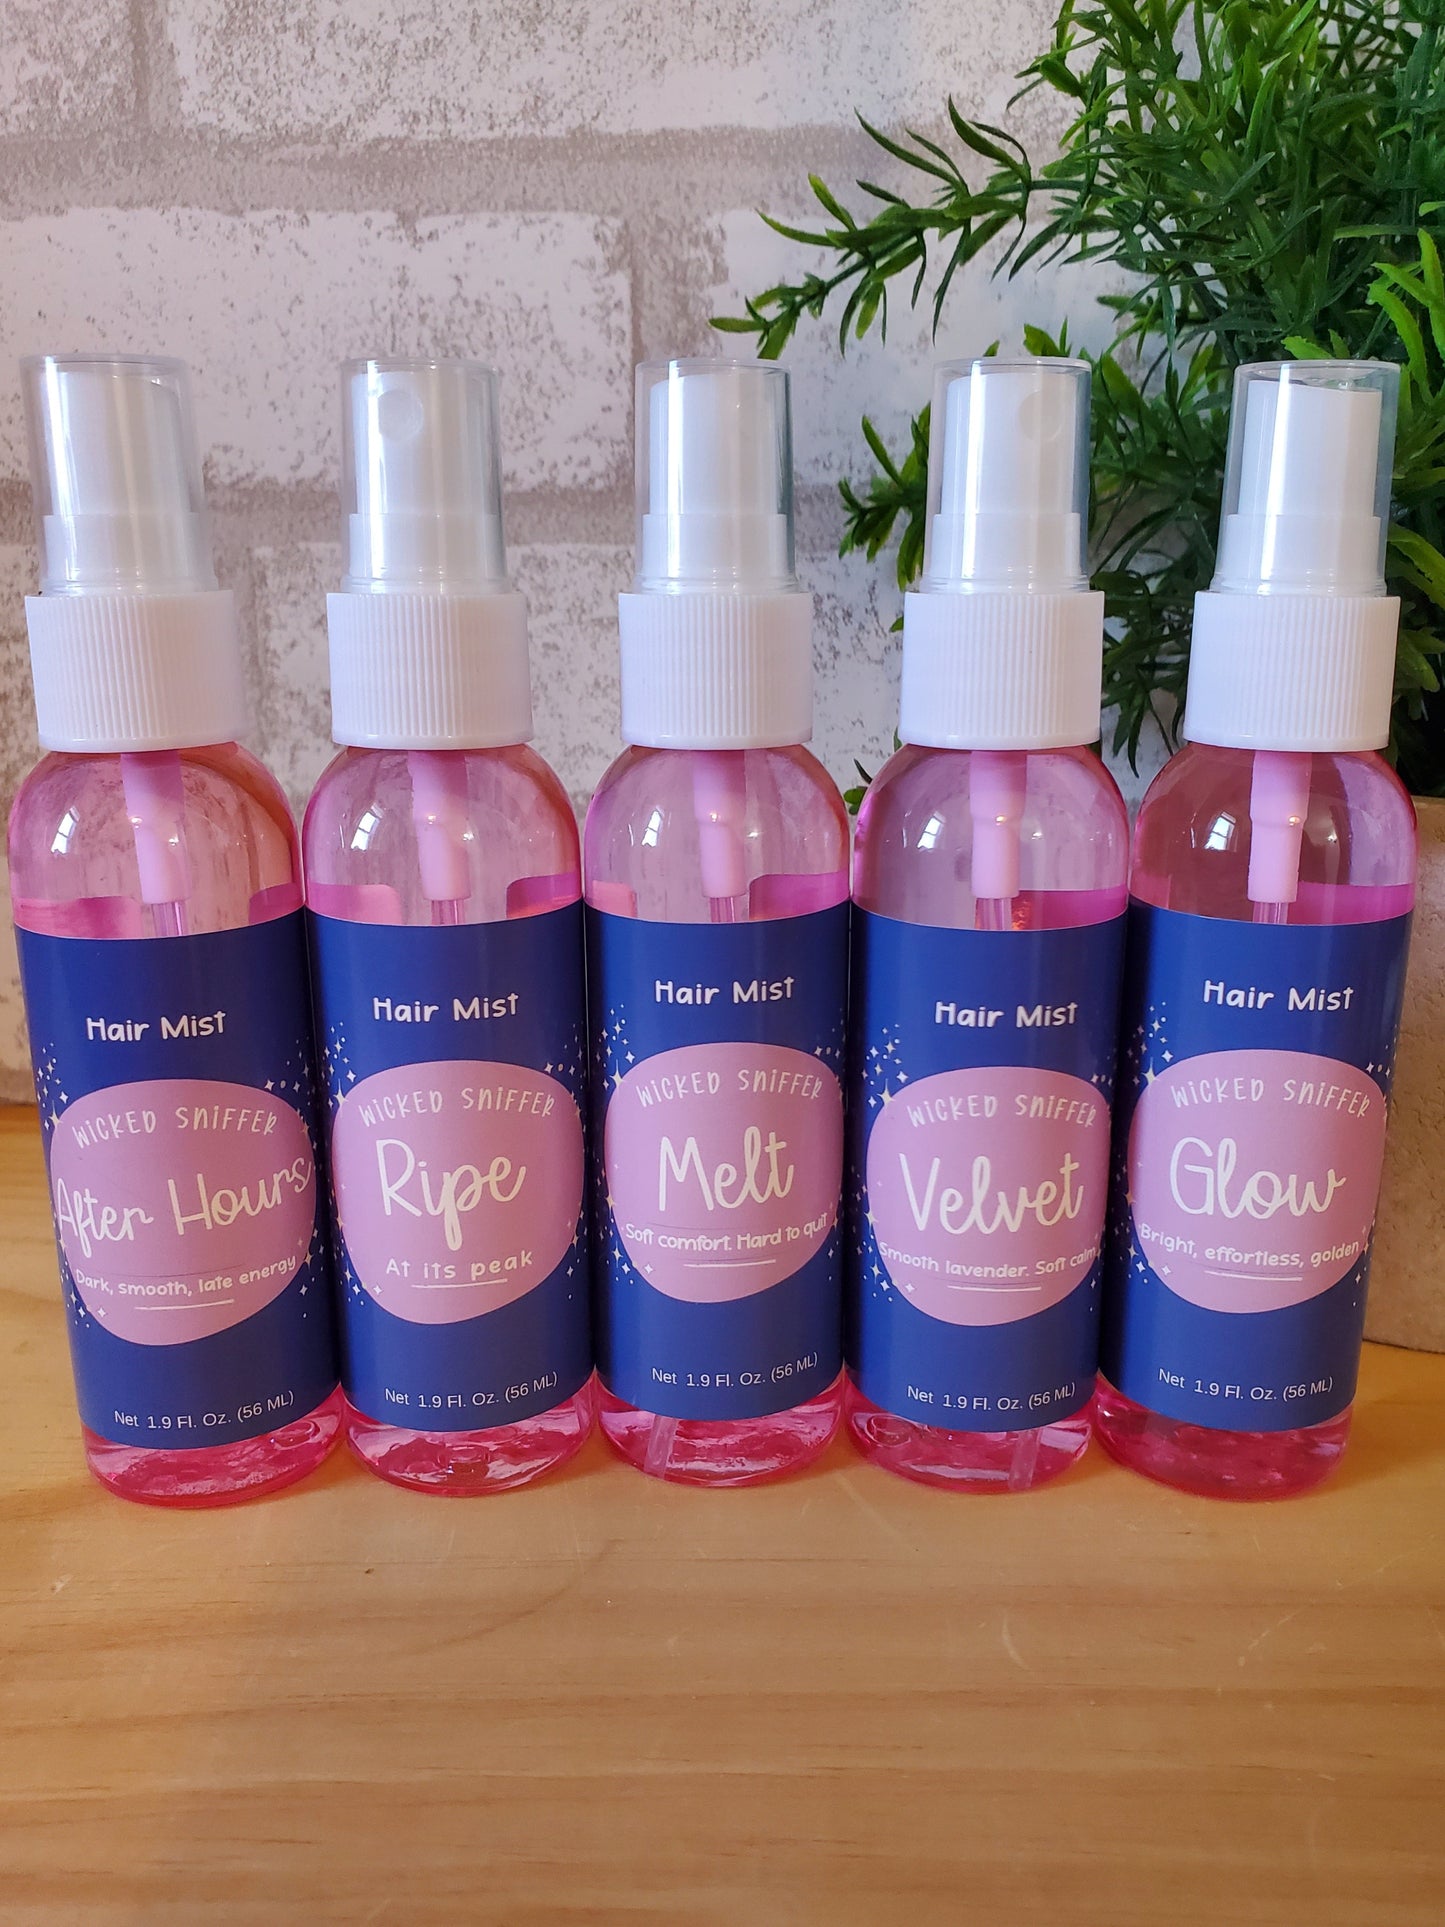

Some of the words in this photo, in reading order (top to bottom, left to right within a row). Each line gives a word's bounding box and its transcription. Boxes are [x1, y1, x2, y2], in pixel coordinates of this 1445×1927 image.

[373, 997, 439, 1023] Hair
[452, 993, 518, 1021] Mist
[655, 980, 720, 1005] Hair
[733, 977, 794, 1004] Mist
[1203, 979, 1275, 1010] Hair
[1288, 987, 1354, 1012] Mist
[86, 1017, 149, 1042] Hair
[160, 1011, 226, 1040] Mist
[935, 1001, 1004, 1028] Hair
[1016, 1002, 1078, 1028] Mist
[659, 1126, 794, 1212] Melt
[1169, 1135, 1347, 1219] Glow
[56, 1177, 154, 1258] After
[167, 1156, 312, 1235] Hours
[375, 1138, 527, 1251] Ripe
[898, 1152, 1084, 1236] Velvet
[626, 1223, 655, 1244] Soft
[737, 1231, 781, 1250] Hard
[785, 1227, 800, 1241] to
[803, 1211, 828, 1241] quit
[1140, 1223, 1197, 1259] Bright,
[1204, 1245, 1304, 1268] effortless,
[1310, 1240, 1359, 1268] golden
[75, 1268, 113, 1296] Dark,
[118, 1281, 193, 1297] smooth,
[198, 1276, 233, 1293] late
[238, 1256, 297, 1284] energy
[386, 1259, 411, 1276] At
[423, 1262, 456, 1280] its
[471, 1250, 533, 1281] peak
[879, 1241, 939, 1273] Smooth
[946, 1259, 1030, 1278] lavender.
[1035, 1256, 1066, 1275] Soft
[651, 1367, 677, 1385] Net
[686, 1373, 710, 1388] 1.9
[715, 1374, 735, 1388] Fl.
[739, 1371, 765, 1386] Oz.
[771, 1364, 793, 1383] (56
[796, 1352, 818, 1372] ML)
[1158, 1367, 1185, 1389] Net
[1193, 1379, 1219, 1396] 1.9
[1224, 1384, 1244, 1399] Fl.
[1249, 1386, 1277, 1401] Oz.
[1283, 1383, 1306, 1402] (56
[1309, 1376, 1334, 1394] ML)
[385, 1388, 409, 1406] Net
[418, 1394, 442, 1409] 1.9
[447, 1394, 467, 1408] Fl.
[472, 1390, 499, 1407] Oz.
[504, 1383, 529, 1403] (56
[533, 1371, 559, 1393] ML)
[907, 1384, 934, 1404] Net
[943, 1394, 967, 1410] 1.9
[972, 1396, 992, 1410] Fl.
[997, 1396, 1023, 1410] Oz.
[1028, 1391, 1051, 1410] (56
[1054, 1382, 1075, 1400] ML)
[114, 1410, 139, 1428] Net
[147, 1415, 172, 1429] 1.9
[177, 1414, 197, 1429] Fl.
[202, 1411, 232, 1427] Oz.
[236, 1401, 263, 1424] (56
[267, 1391, 295, 1410] ML)
